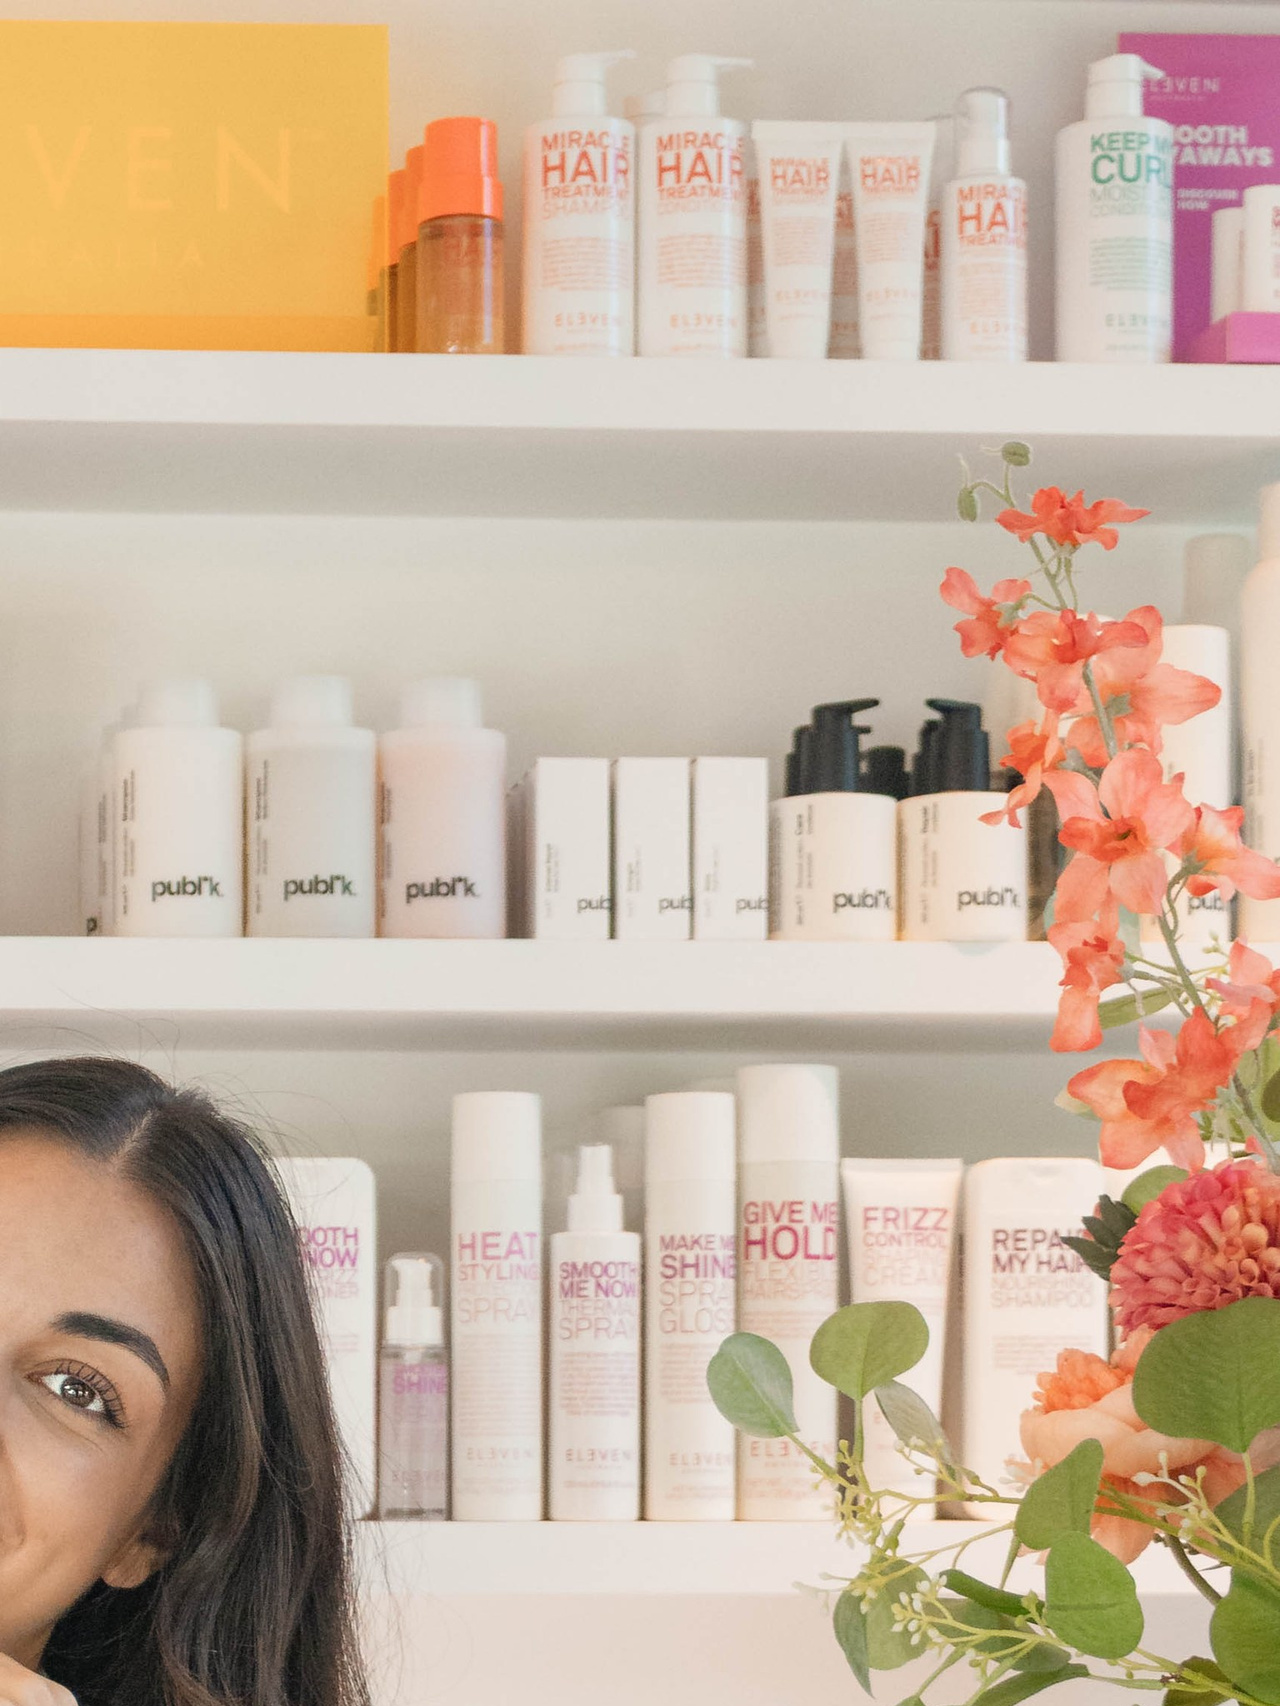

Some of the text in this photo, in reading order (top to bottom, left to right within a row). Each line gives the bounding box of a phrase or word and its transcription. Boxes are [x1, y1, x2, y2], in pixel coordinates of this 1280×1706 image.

[541, 131, 630, 152] MIRACE
[657, 131, 744, 151] MIRACE
[1090, 132, 1148, 152] KEEP
[1176, 125, 1247, 145] OOTH
[541, 150, 630, 187] HAIR
[657, 150, 743, 187] HAIR
[771, 167, 829, 188] HAIR
[861, 166, 920, 187] HAIR
[744, 1201, 804, 1225] GIVE
[863, 1206, 948, 1232] FRIZZ
[458, 1231, 538, 1261] HEAT
[659, 1234, 716, 1252] MAKE
[862, 1231, 947, 1249] CONTROL
[457, 1262, 540, 1282] STYLING
[992, 1251, 1030, 1274] MY
[559, 1280, 637, 1299] ME NOW
